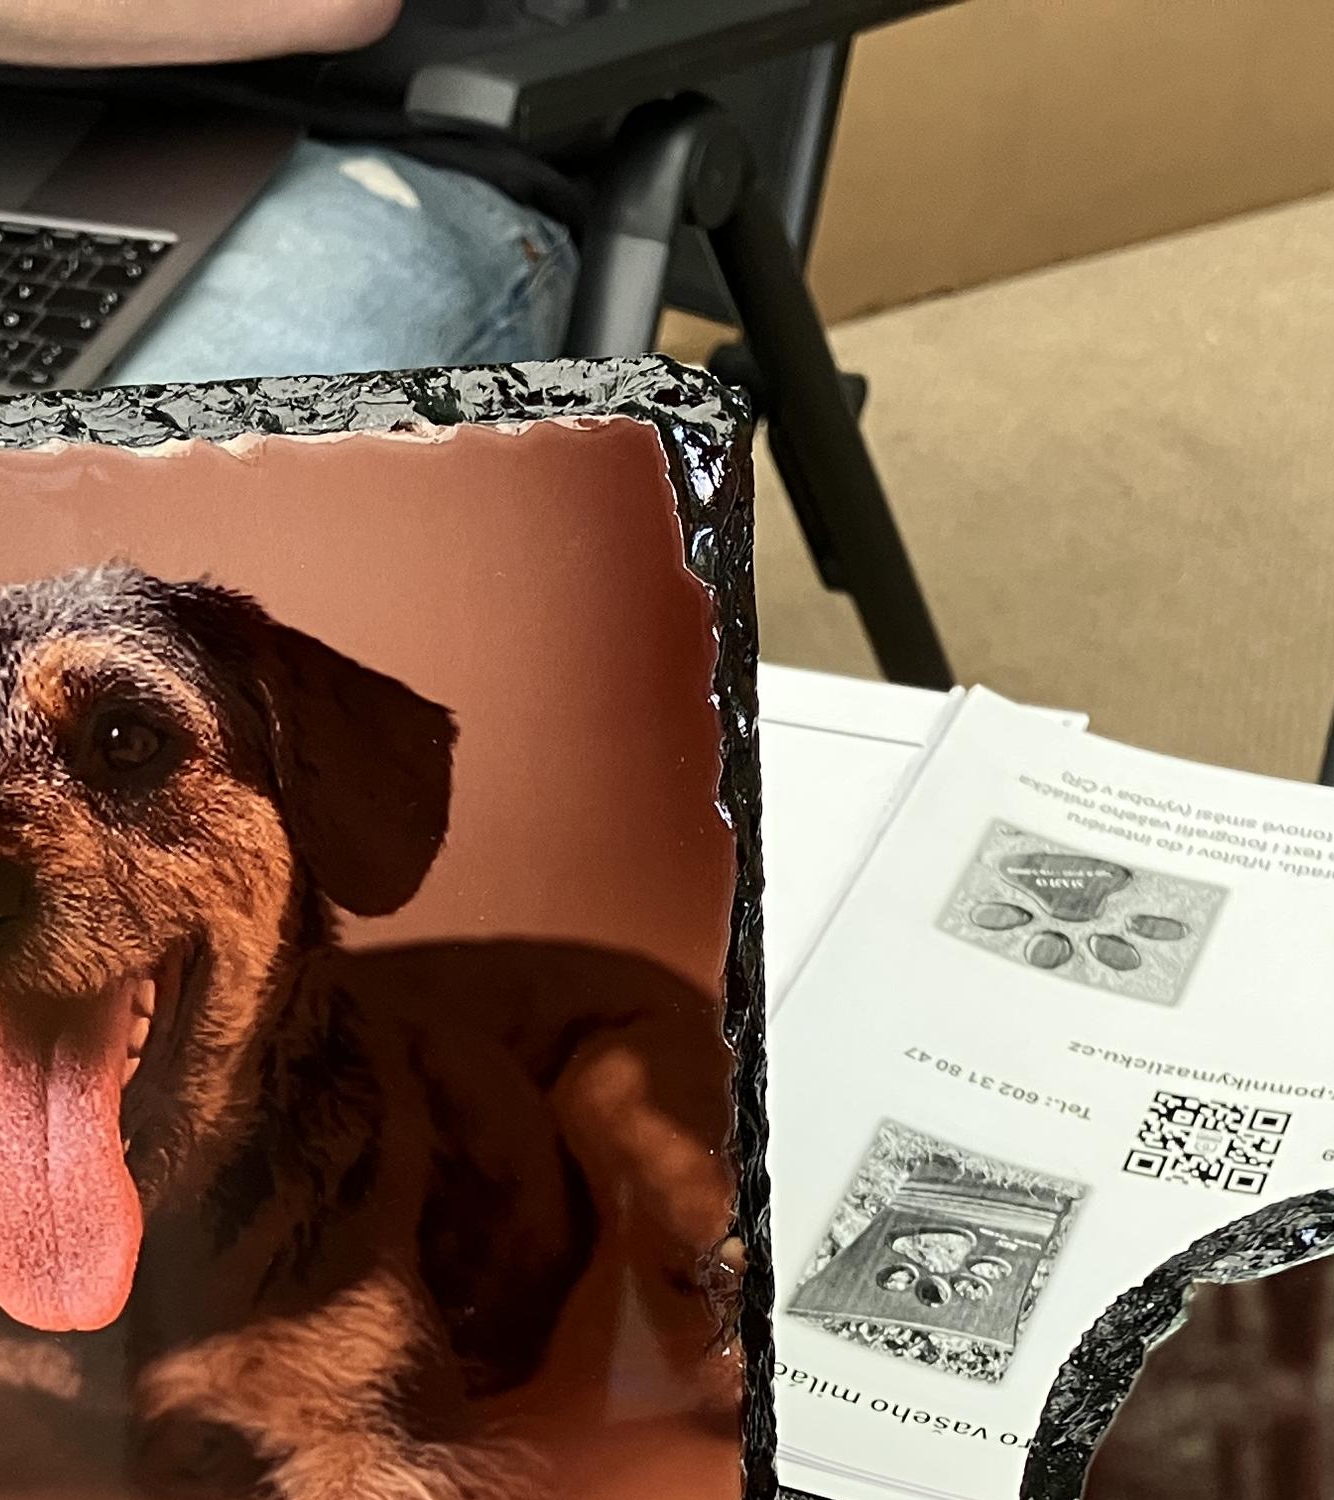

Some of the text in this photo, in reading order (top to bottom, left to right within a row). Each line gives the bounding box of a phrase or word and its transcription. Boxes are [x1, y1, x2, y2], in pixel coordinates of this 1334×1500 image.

[903, 1046, 1092, 1121] Tel.: 602 31 80 47
[773, 1360, 1034, 1449] ro vašeho miláč
